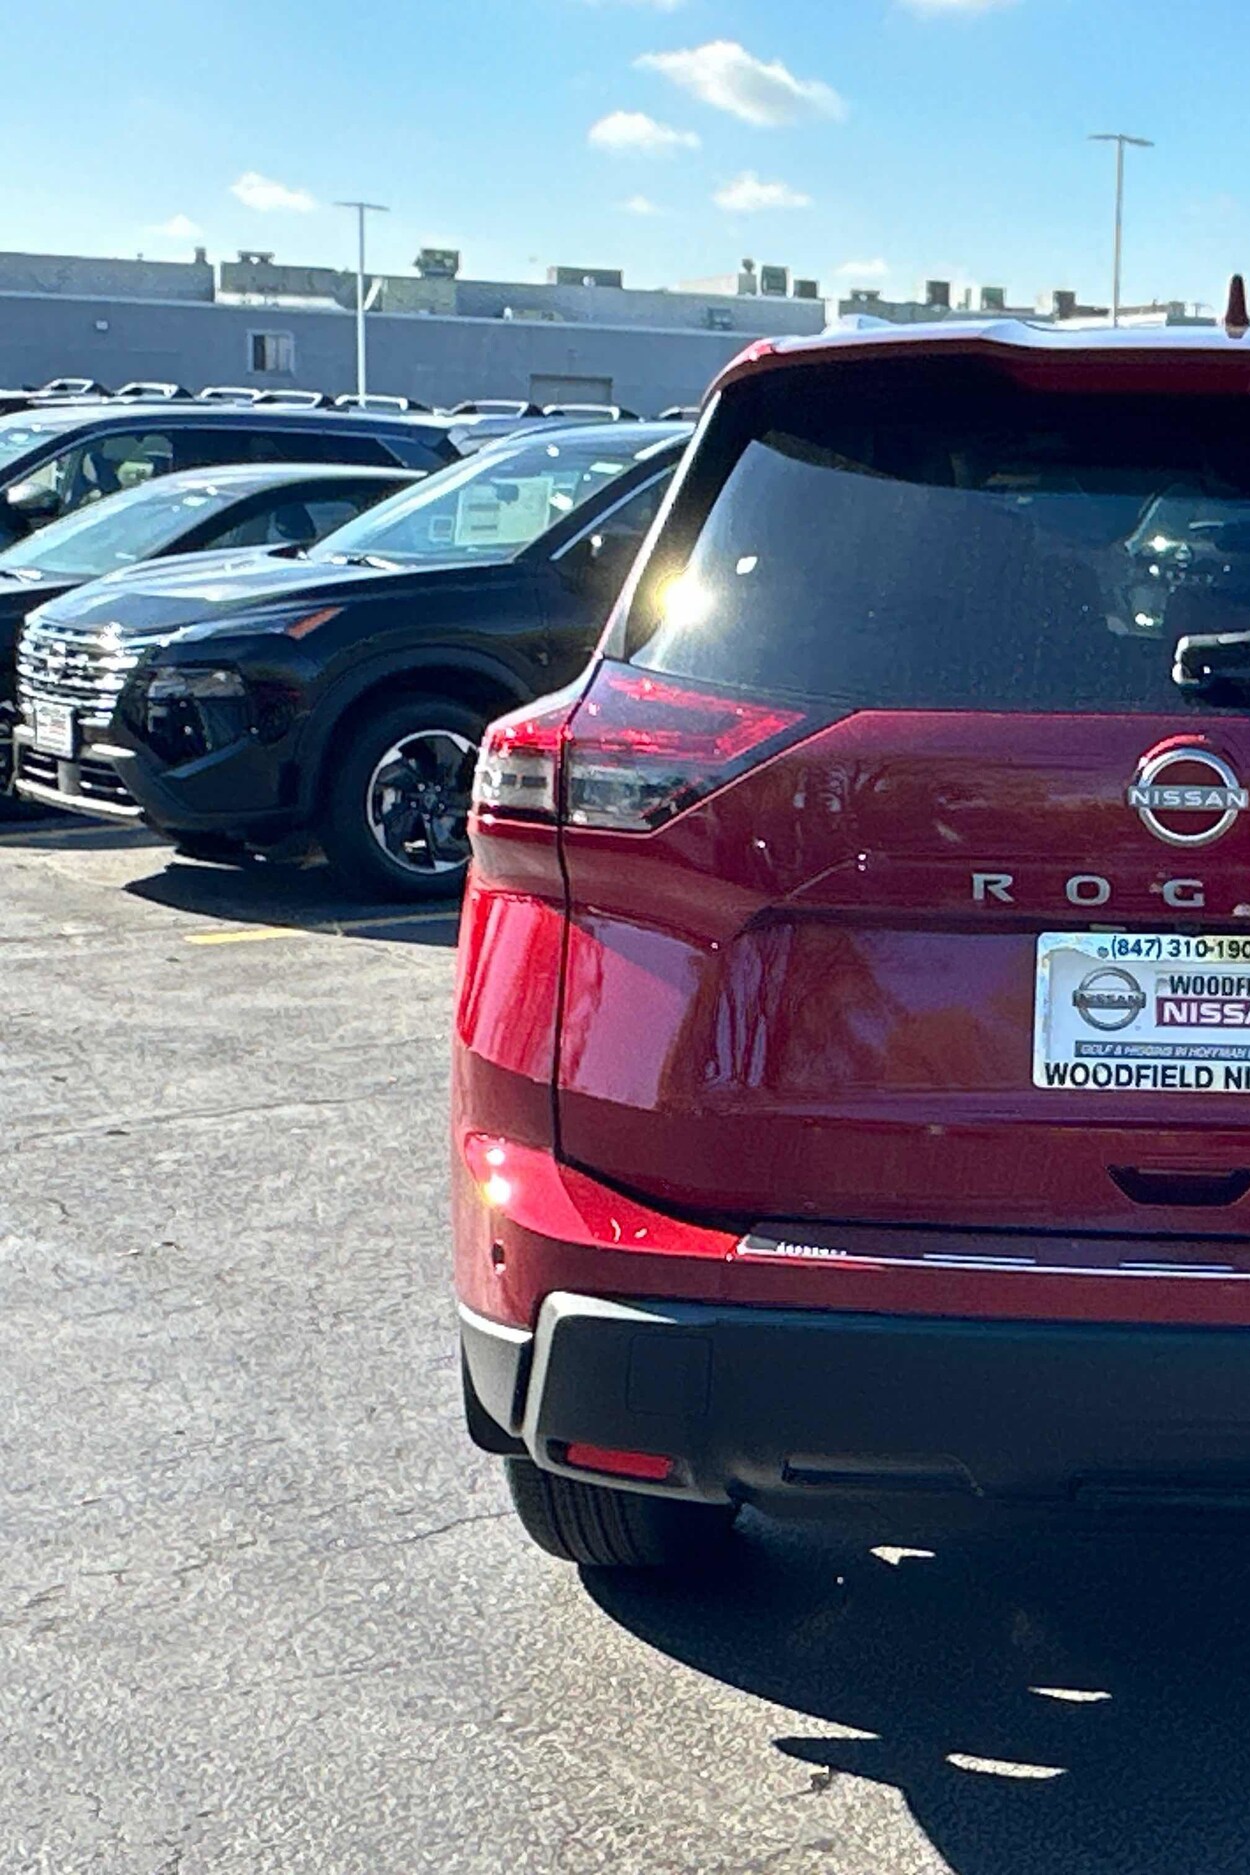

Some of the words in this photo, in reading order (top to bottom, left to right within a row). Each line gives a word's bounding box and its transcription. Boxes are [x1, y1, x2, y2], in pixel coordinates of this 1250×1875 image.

[1130, 789, 1247, 808] NISSAN
[1111, 936, 1162, 960] (847)
[1045, 1062, 1214, 1089] WOODFIELD
